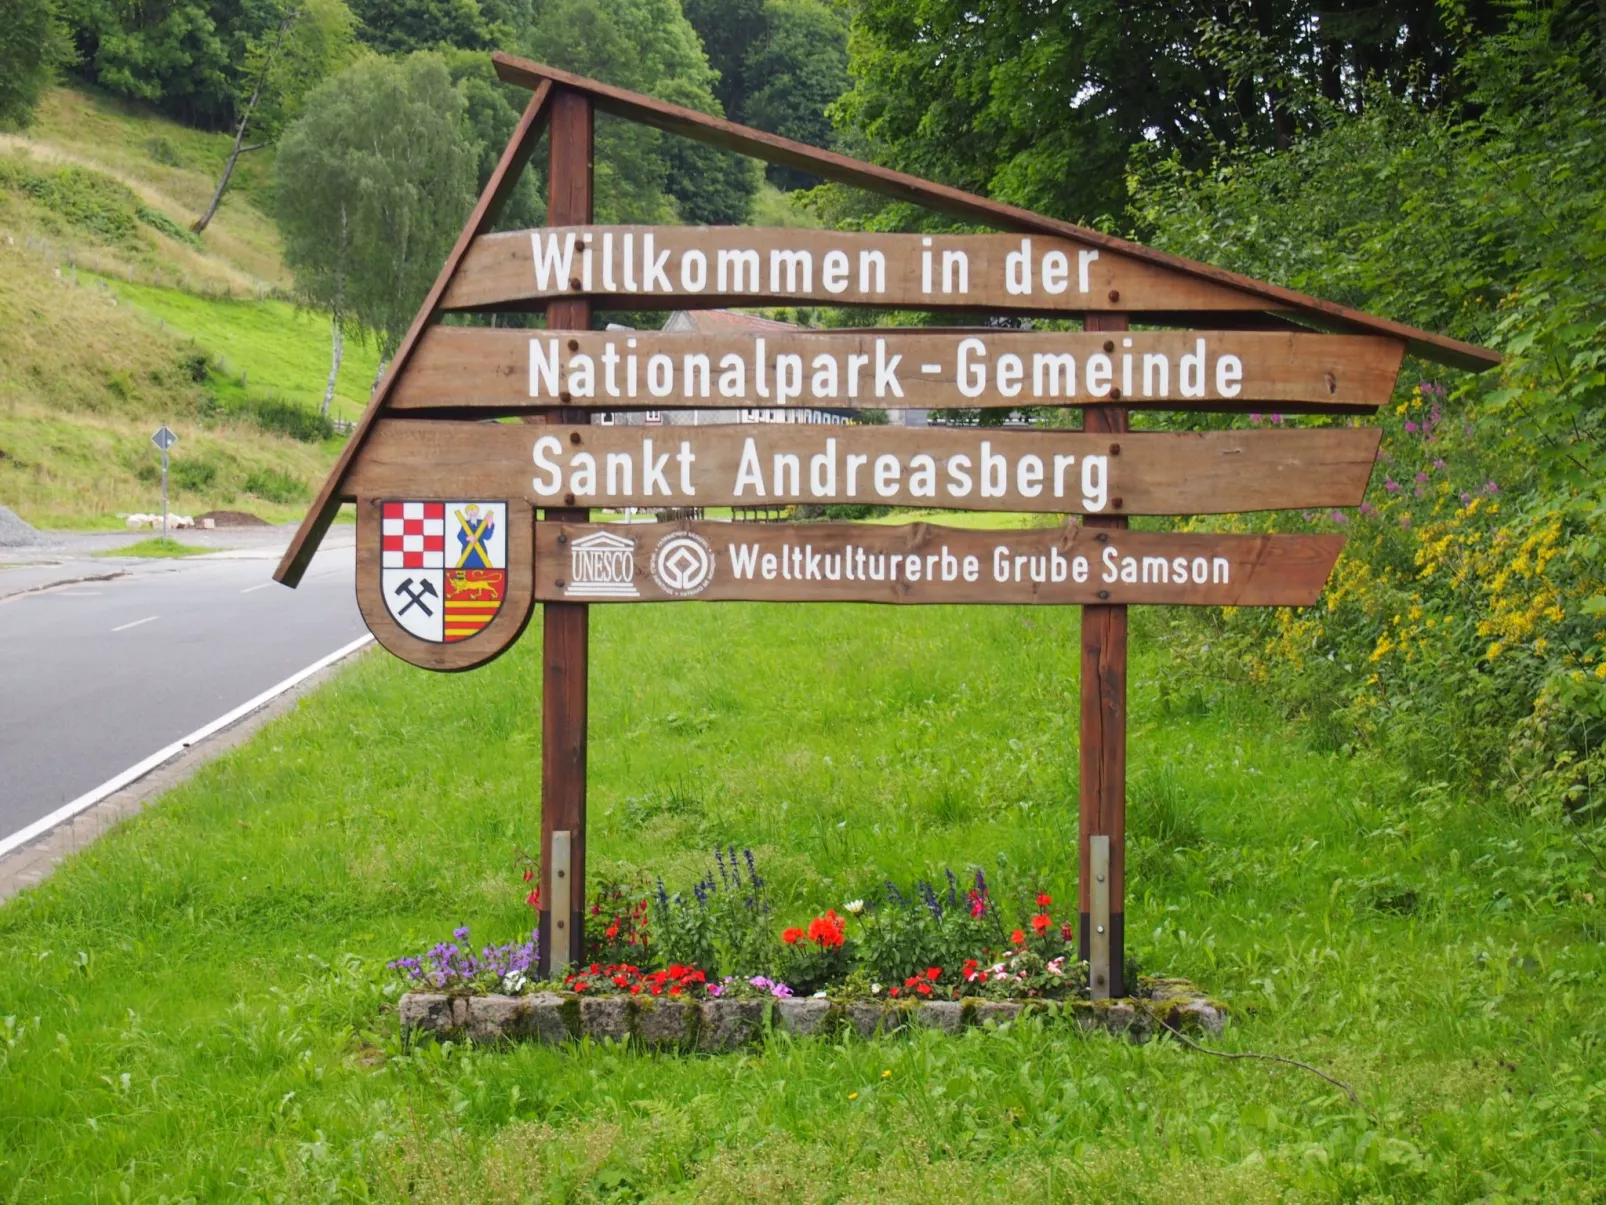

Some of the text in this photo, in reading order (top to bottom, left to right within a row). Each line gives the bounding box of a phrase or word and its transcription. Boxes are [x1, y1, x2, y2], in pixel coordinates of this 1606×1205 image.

[531, 231, 1099, 295] Willkommen in der
[532, 434, 1109, 513] Sankt Andreasberg
[571, 551, 635, 582] UNESCO
[729, 543, 980, 582] Weltkulturerbe
[993, 545, 1089, 584] Grube
[1101, 546, 1230, 584] Samson
